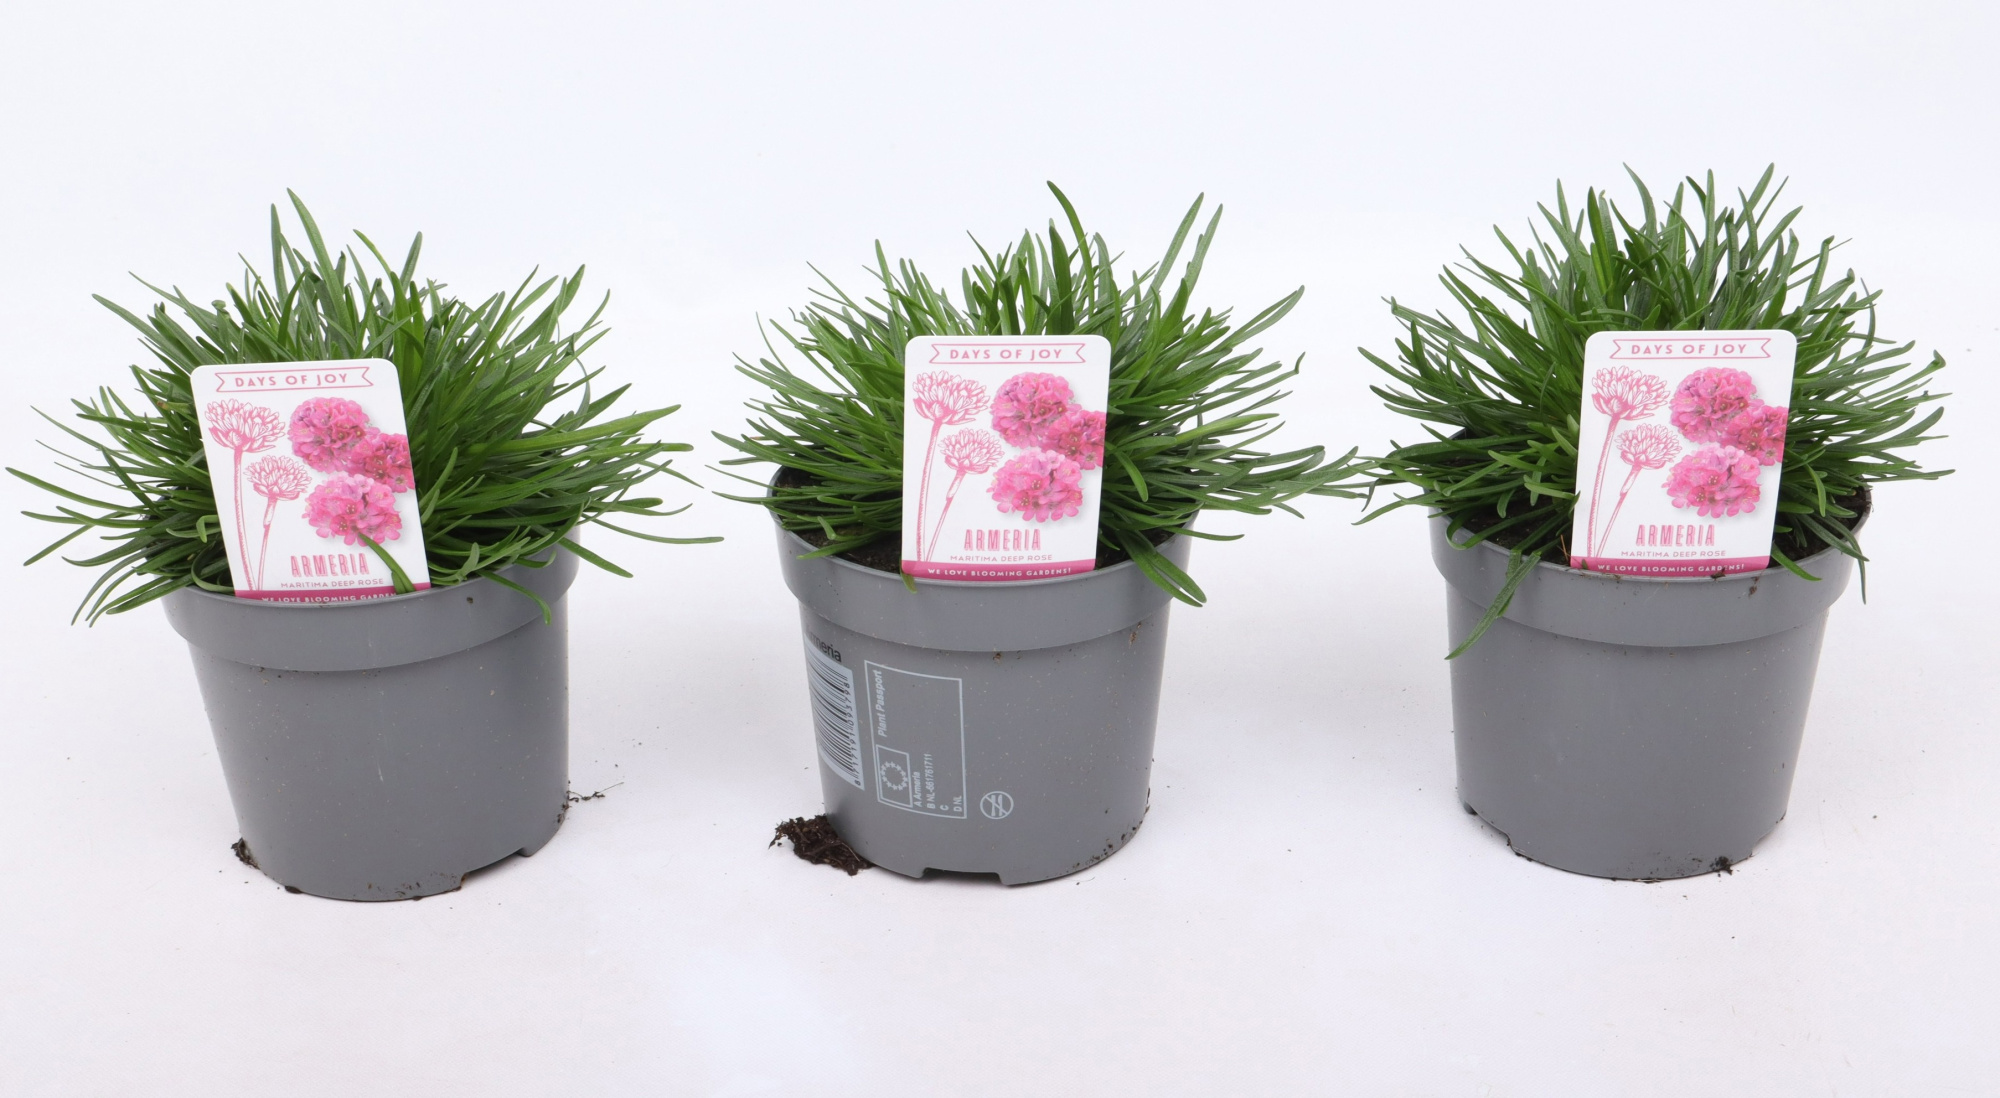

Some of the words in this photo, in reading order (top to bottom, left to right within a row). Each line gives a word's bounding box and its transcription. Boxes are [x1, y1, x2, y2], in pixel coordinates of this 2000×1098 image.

[950, 350, 990, 359] DAYS
[1000, 349, 1022, 359] OF
[1030, 349, 1062, 361] JOY
[1632, 345, 1672, 354] DAYS
[1682, 344, 1705, 354] OF
[1713, 344, 1747, 356] JOY
[235, 376, 276, 387] DAYS
[285, 375, 307, 385] OF
[317, 373, 348, 386] JOY
[964, 529, 1041, 551] ARMERIA
[1636, 524, 1715, 546] ARMERIA
[290, 553, 370, 577] ARMERIA
[1026, 567, 1071, 576] GARDENS!
[873, 669, 887, 712] Passport
[876, 713, 887, 737] Plant
[912, 772, 922, 800] Armeria
[953, 796, 962, 804] NL
